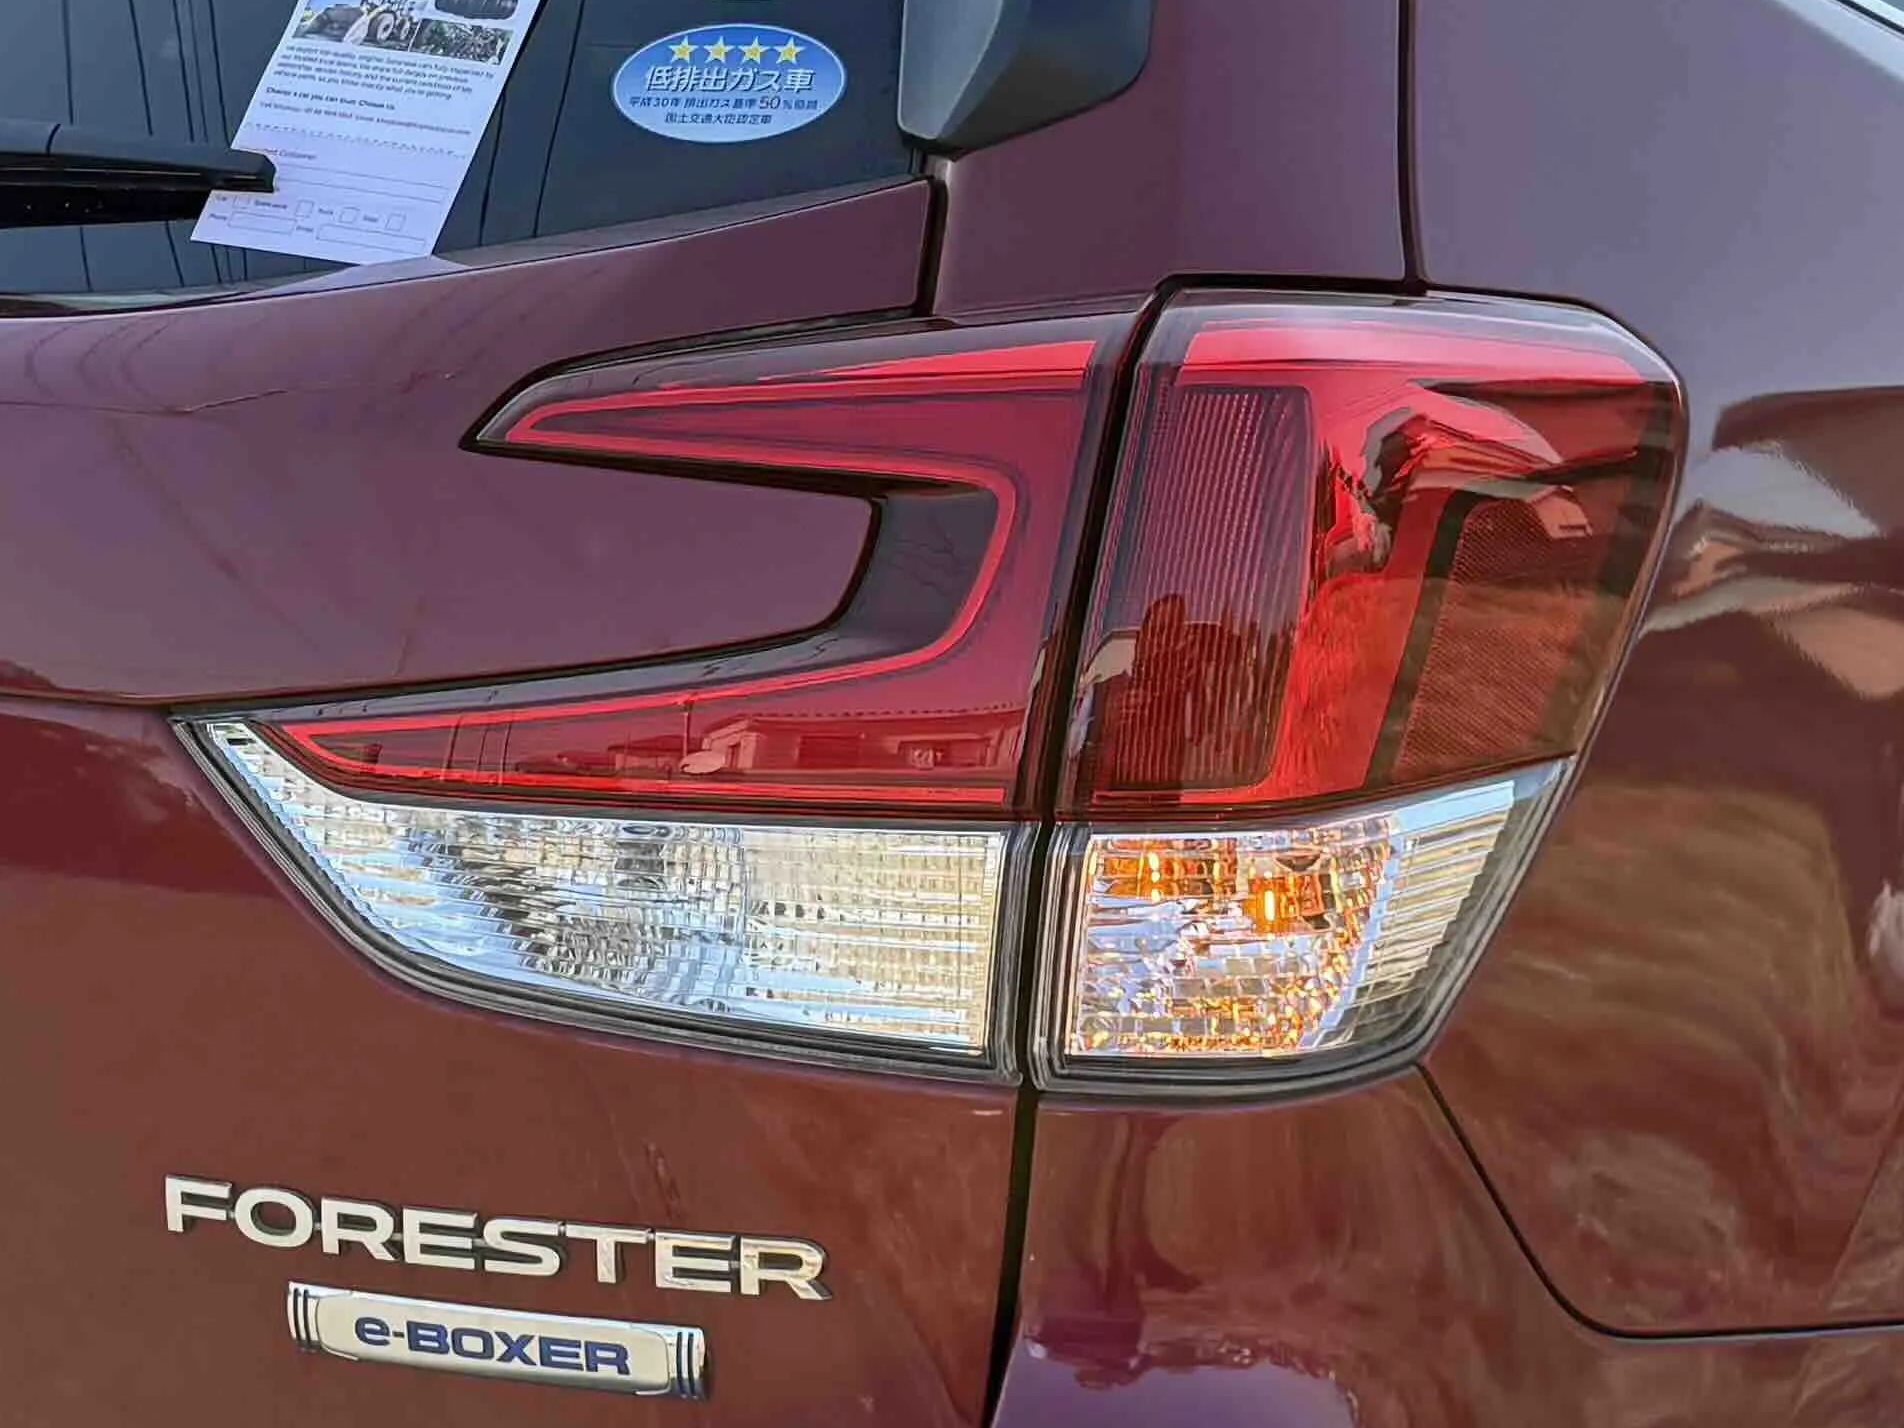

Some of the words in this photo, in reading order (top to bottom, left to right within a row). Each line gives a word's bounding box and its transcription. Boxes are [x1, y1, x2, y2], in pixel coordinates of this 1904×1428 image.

[646, 64, 816, 94] 低排出ガス車
[163, 1173, 834, 1301] FORESTER
[353, 1316, 632, 1375] e-BOXER
